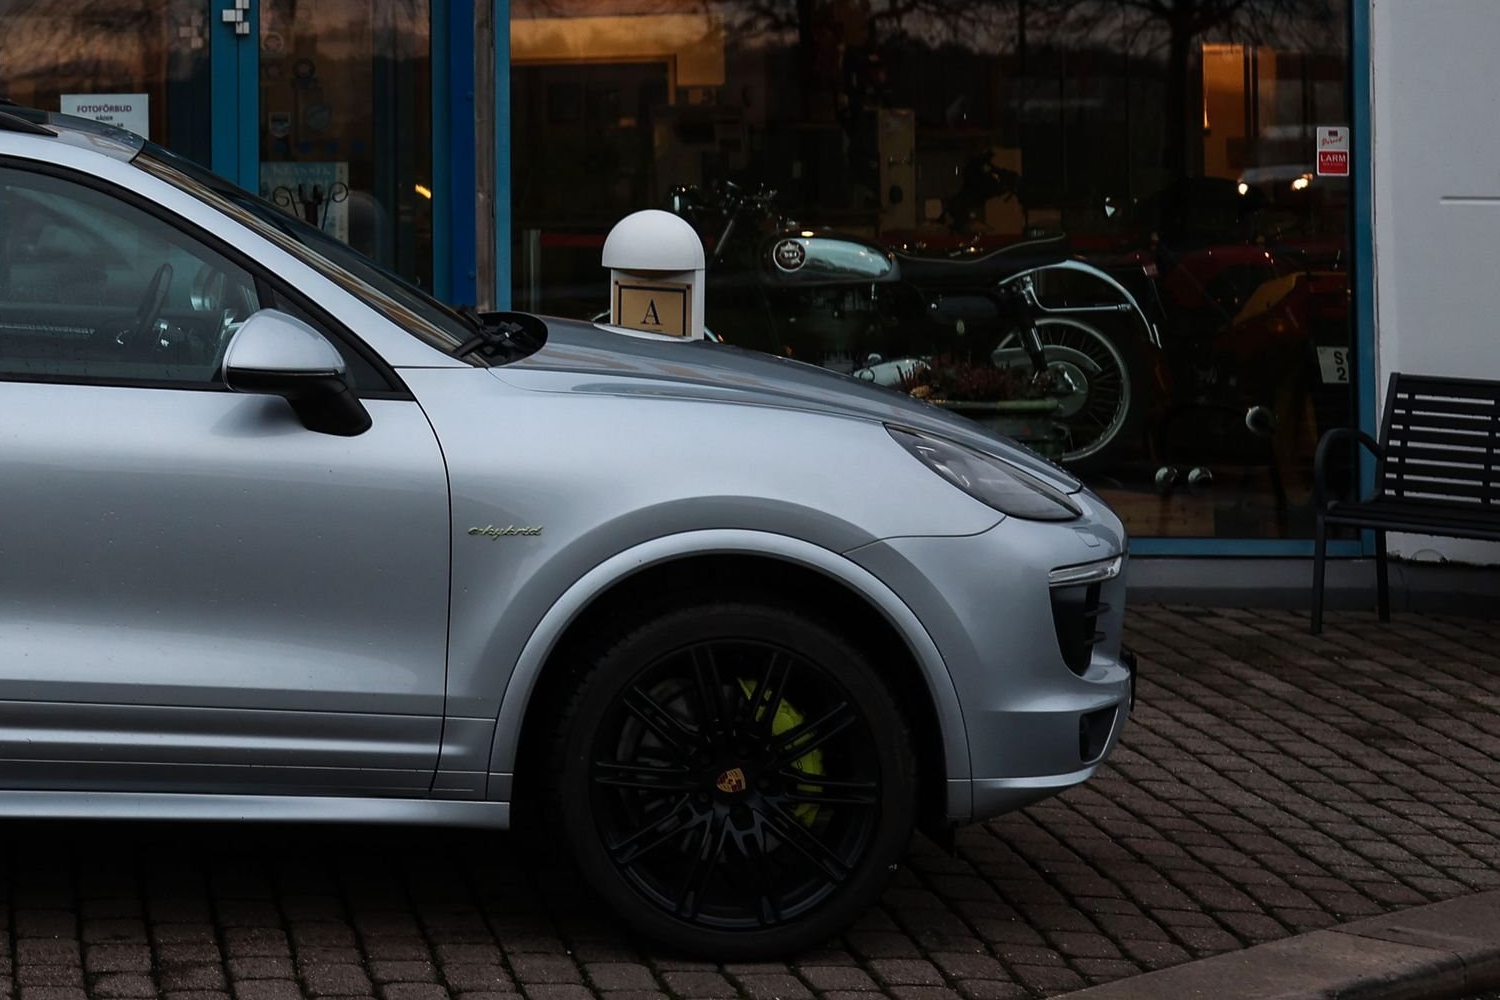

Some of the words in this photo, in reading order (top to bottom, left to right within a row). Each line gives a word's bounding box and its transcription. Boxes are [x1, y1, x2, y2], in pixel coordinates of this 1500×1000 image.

[76, 103, 133, 113] FOTOFÖRBUD
[1320, 154, 1346, 163] LARM
[640, 299, 664, 325] A
